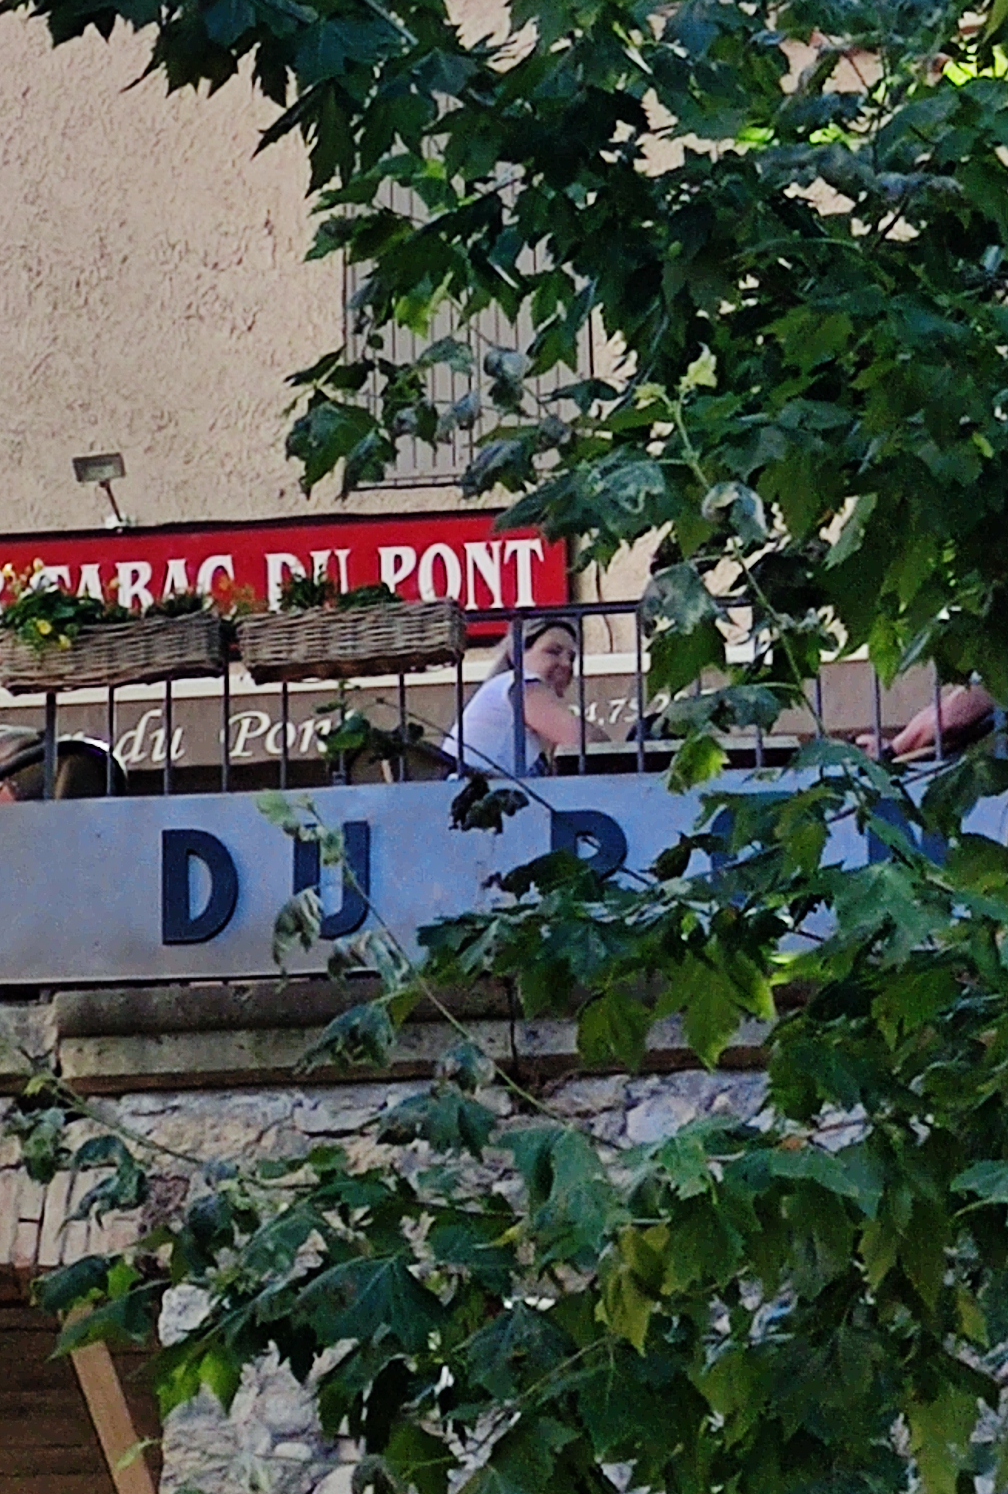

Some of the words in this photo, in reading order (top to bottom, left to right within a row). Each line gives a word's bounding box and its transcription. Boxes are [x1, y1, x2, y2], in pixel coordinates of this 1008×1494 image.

[265, 548, 351, 613] DU
[378, 537, 545, 611] PONT
[112, 709, 186, 764] du
[219, 709, 358, 758] Pon
[161, 820, 372, 946] DU
